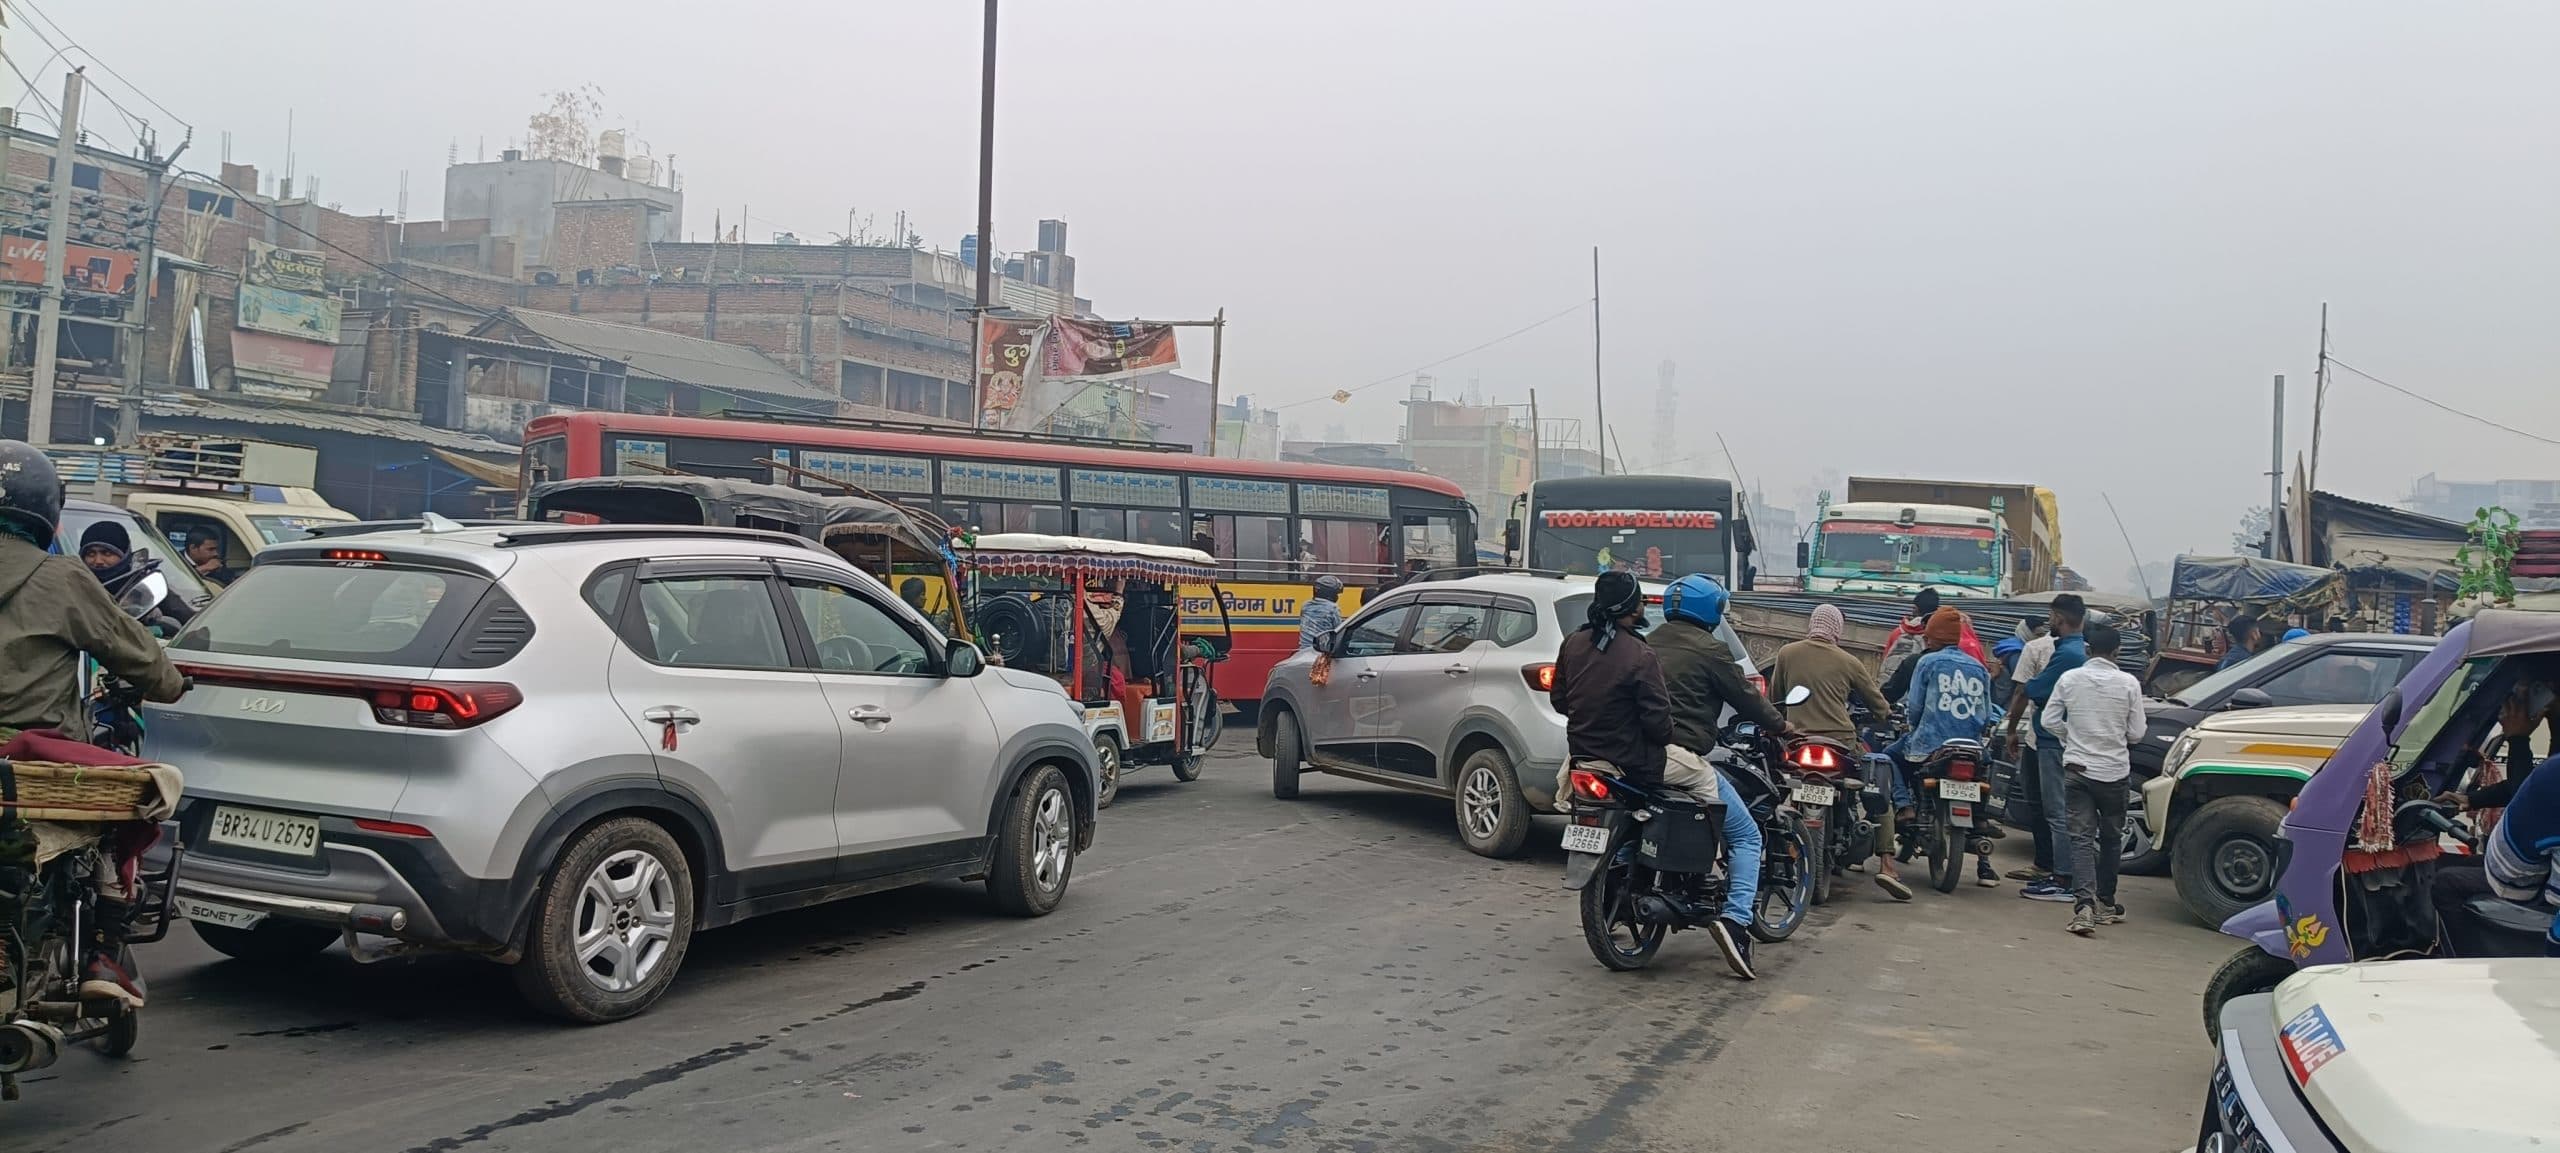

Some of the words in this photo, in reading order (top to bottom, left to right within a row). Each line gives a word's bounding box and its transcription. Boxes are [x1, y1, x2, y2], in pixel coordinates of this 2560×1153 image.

[1545, 512, 1626, 528] TOOFAN
[1635, 512, 1717, 529] DELUXE
[1937, 669, 1984, 697] BAD
[1937, 692, 1983, 720] BOY
[221, 813, 260, 839] BR34
[261, 819, 273, 841] U
[274, 821, 315, 849] 2679
[2283, 1008, 2339, 1073] POLICE
